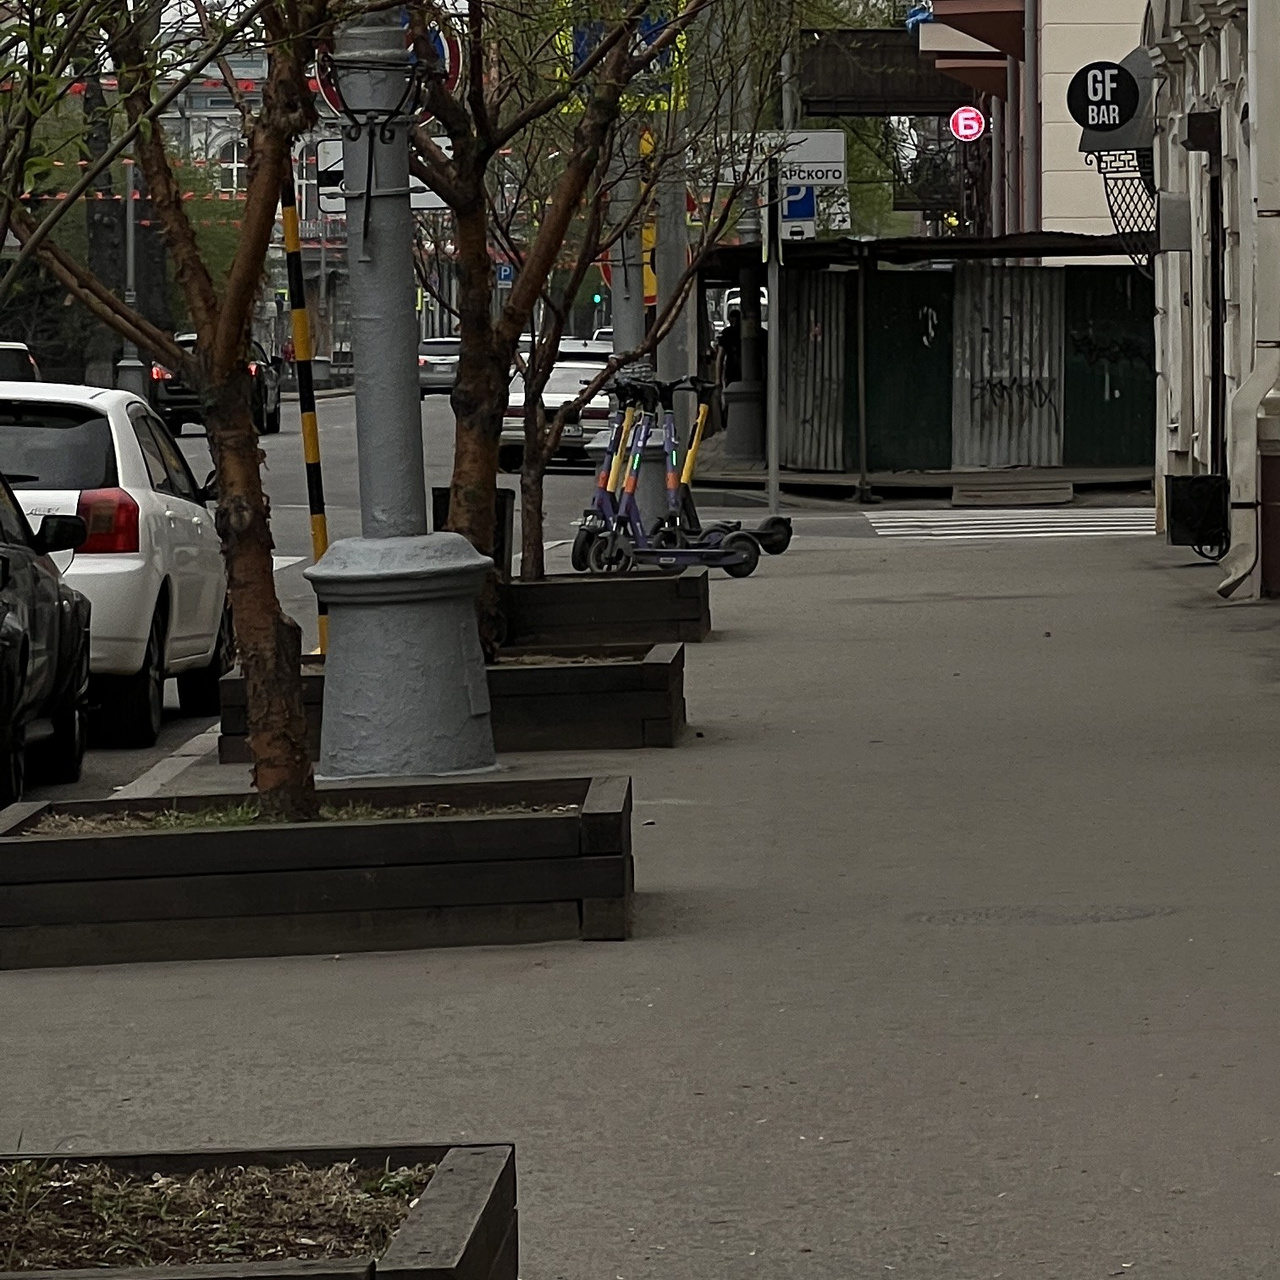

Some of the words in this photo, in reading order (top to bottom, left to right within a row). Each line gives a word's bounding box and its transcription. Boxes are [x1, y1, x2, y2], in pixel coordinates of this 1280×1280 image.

[1087, 69, 1118, 102] GF
[1088, 105, 1119, 125] BAR
[501, 266, 511, 280] P
